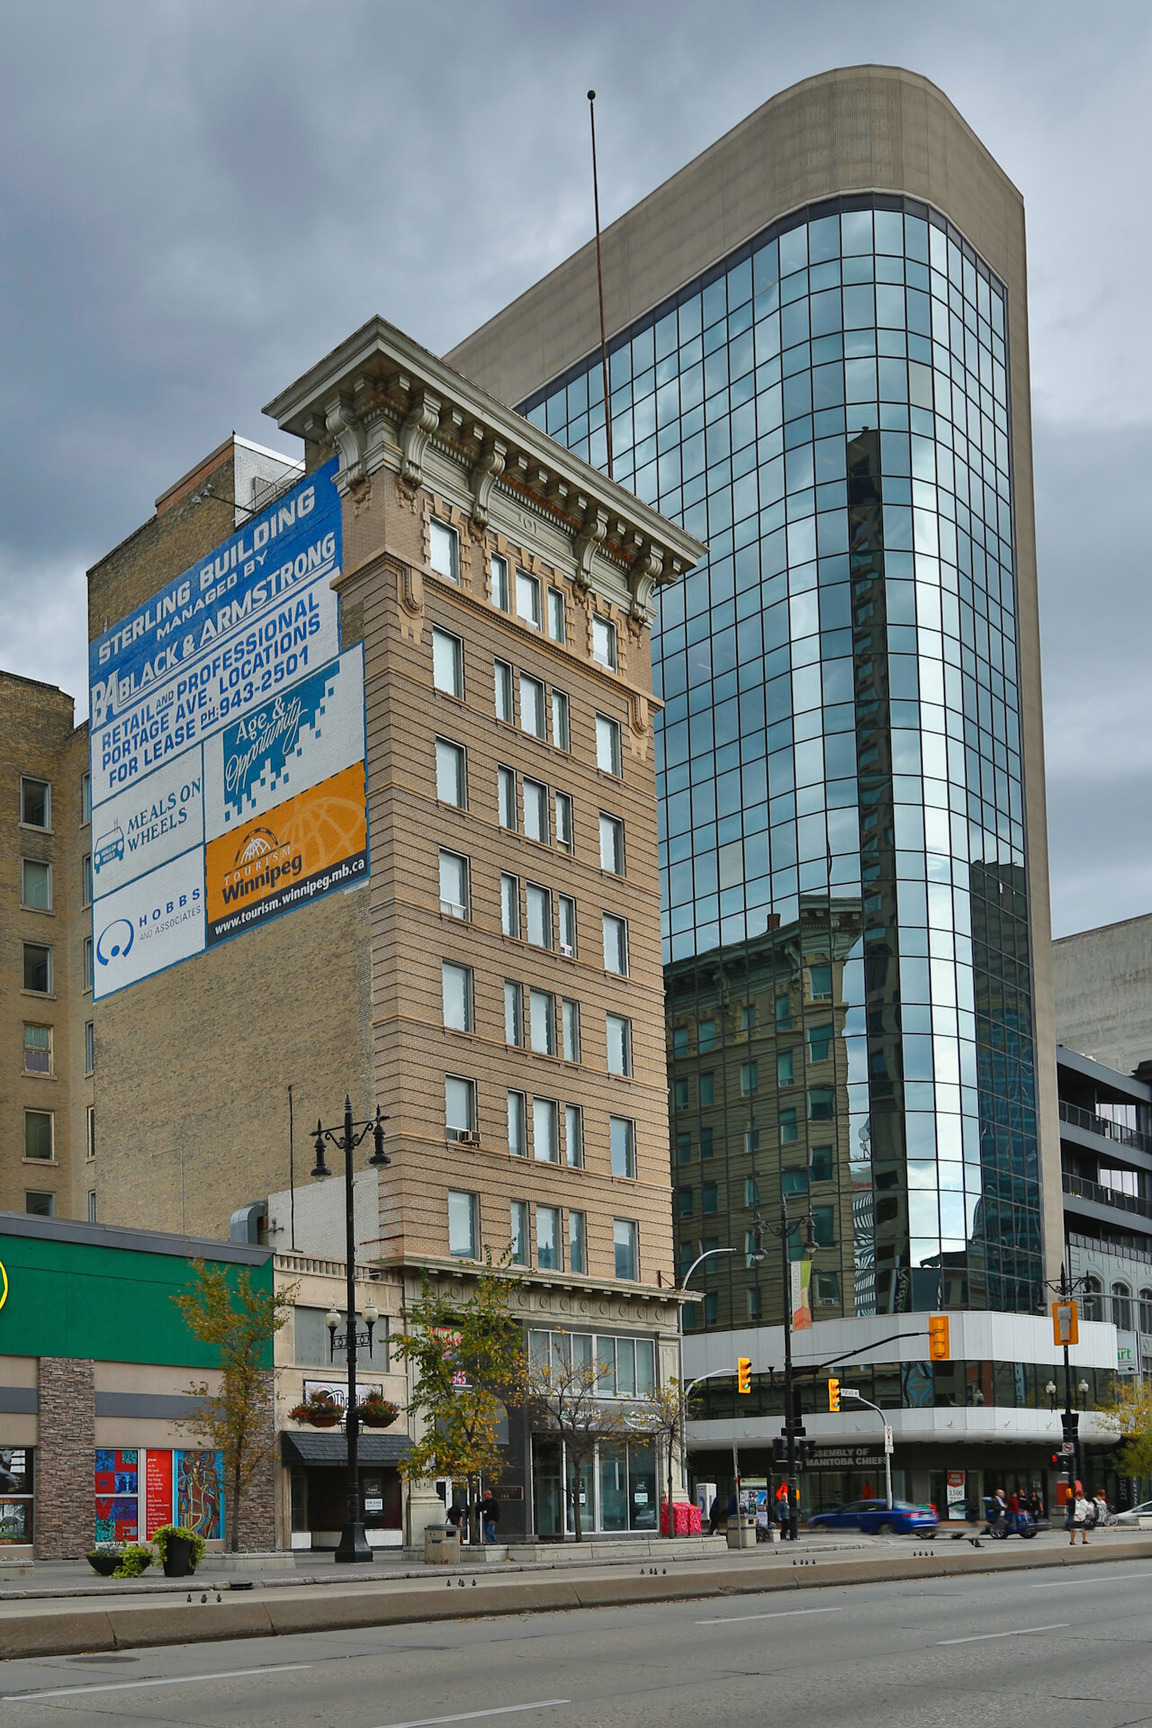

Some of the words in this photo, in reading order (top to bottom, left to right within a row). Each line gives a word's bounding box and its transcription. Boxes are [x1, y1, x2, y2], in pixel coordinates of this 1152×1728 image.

[98, 580, 190, 665] STERLING
[200, 485, 315, 591] BUILDING
[156, 577, 237, 642] MANAGED
[244, 551, 268, 578] BY
[119, 643, 180, 700] BLACK
[182, 635, 195, 657] &
[200, 532, 336, 645] ARMSTRONG
[102, 705, 155, 752] RETAIL
[156, 690, 174, 710] AND
[177, 592, 320, 701] PROFESSIONAL
[102, 712, 169, 771] PORTAGE
[175, 688, 212, 724] AVE.
[219, 613, 321, 695] LOCATIONS
[225, 697, 308, 792] Opportunity
[235, 713, 268, 744] Age
[272, 696, 287, 717] &
[109, 757, 138, 788] FOR
[144, 718, 196, 766] LEASE
[127, 793, 177, 835] MEALS
[180, 778, 202, 804] ON
[127, 807, 188, 852] WHEELS
[221, 854, 303, 905] Winnipeg
[223, 846, 292, 886] TOURISM
[138, 887, 201, 928] HOBBS
[214, 857, 366, 935] www.tourism.winnipeg.mb.ca
[139, 929, 152, 942] AND
[154, 908, 201, 935] ASSOCIATES
[806, 1458, 855, 1467] MANITOBA
[856, 1448, 870, 1456] OF
